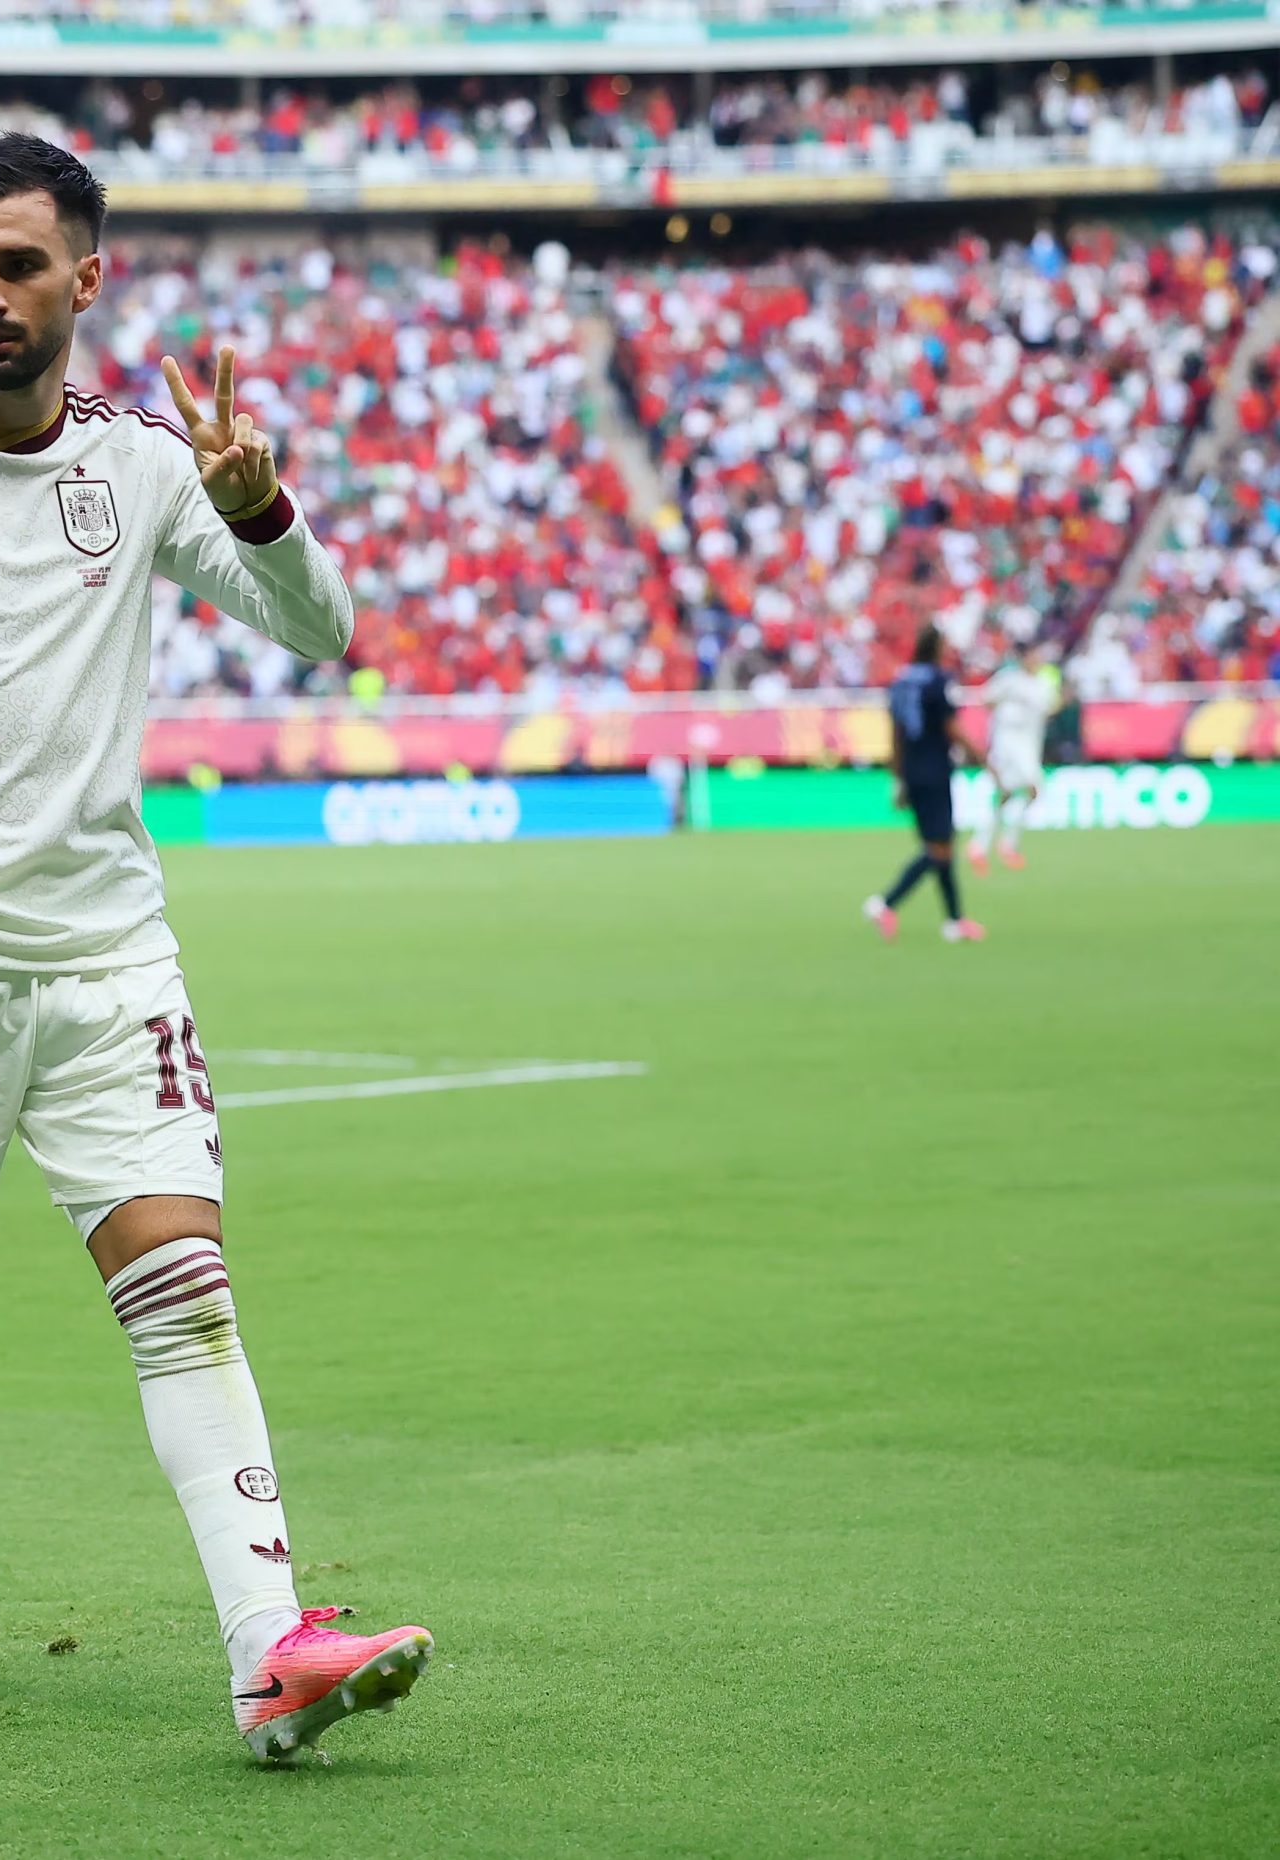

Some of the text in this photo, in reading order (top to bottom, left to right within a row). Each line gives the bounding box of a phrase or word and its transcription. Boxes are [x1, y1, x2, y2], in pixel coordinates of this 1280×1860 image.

[145, 1014, 215, 1114] 15
[245, 1473, 270, 1483] RF
[250, 1485, 271, 1494] EF
